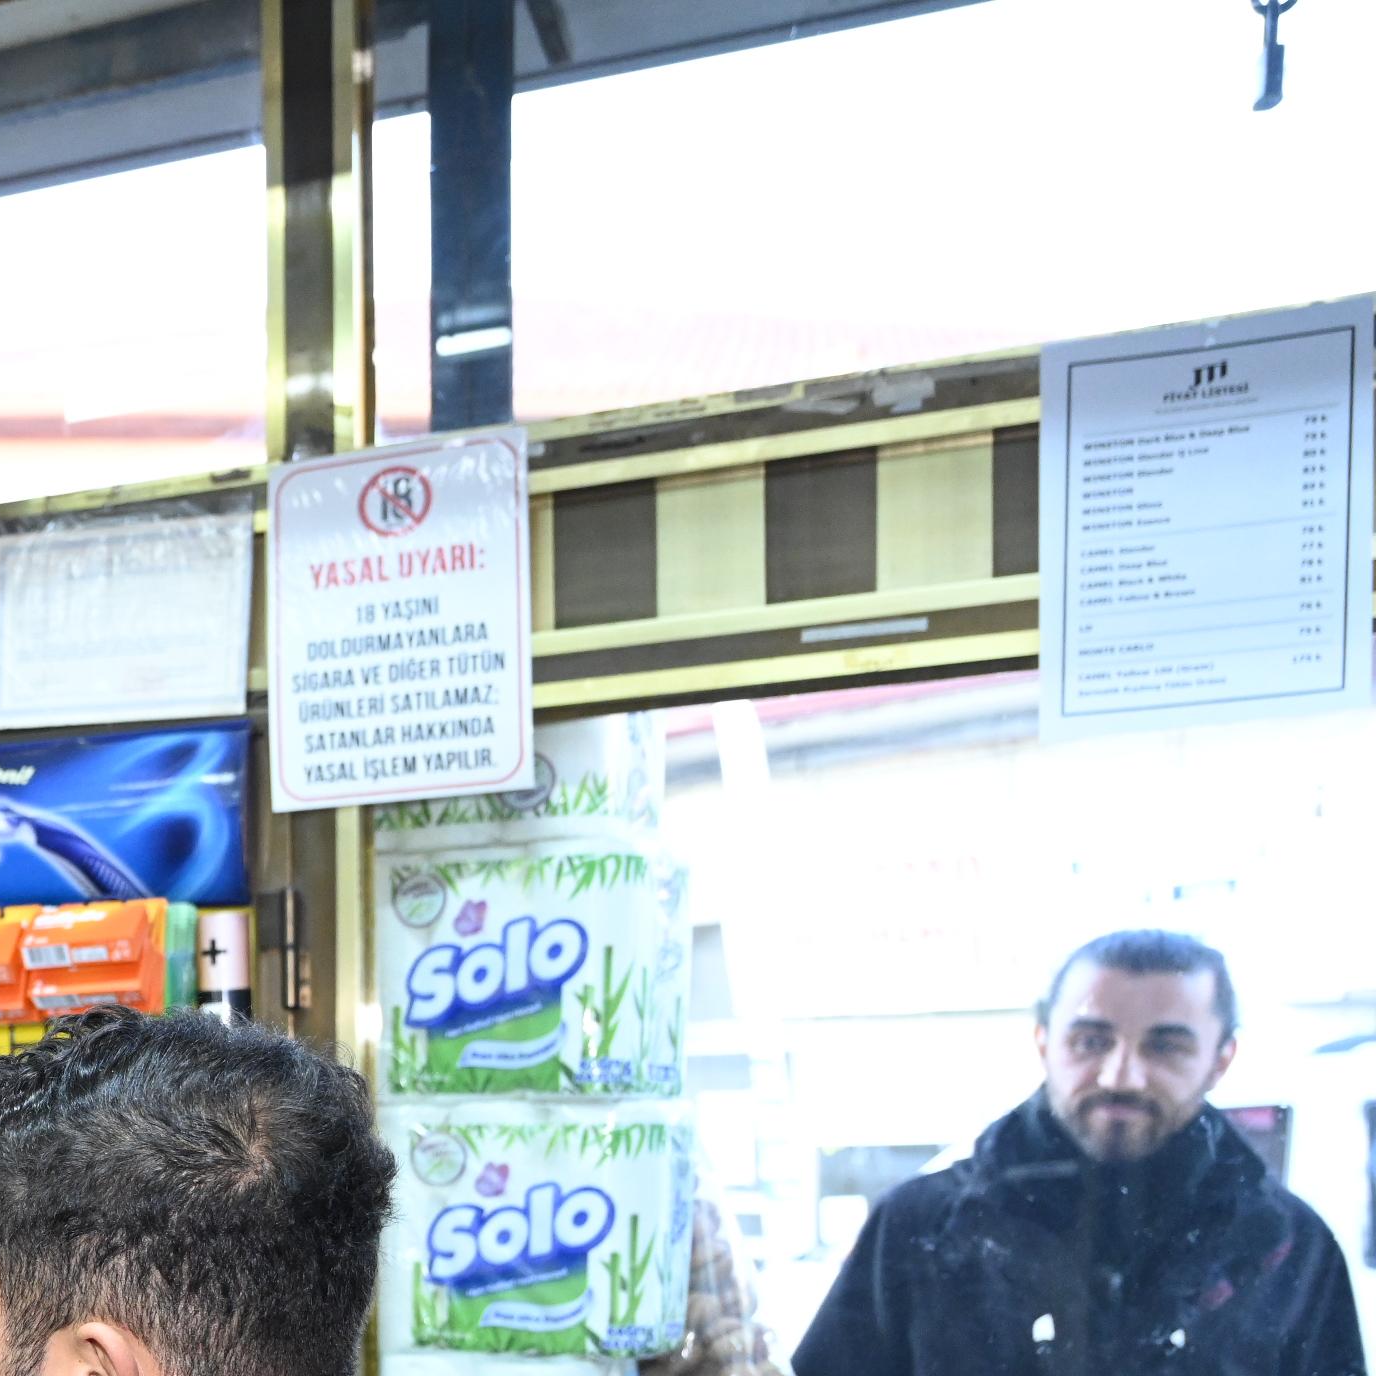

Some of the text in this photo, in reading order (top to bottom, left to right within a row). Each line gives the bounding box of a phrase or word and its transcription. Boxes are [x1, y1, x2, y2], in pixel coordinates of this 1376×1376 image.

[310, 542, 487, 591] YASAL UYARI:
[356, 595, 440, 625] 18 YAŞINI
[307, 621, 489, 662] DOLDURMAYANLARA
[292, 651, 505, 694] SİGARA VE DİĞER TÜTÜN
[298, 694, 385, 724] ÜRÜNLERİ
[304, 716, 495, 754] SATANLAR HAKKINDA
[304, 758, 358, 785] YASAL
[363, 754, 417, 782] İŞLEM
[405, 914, 589, 1027] Solo
[427, 1182, 615, 1286] Solo
